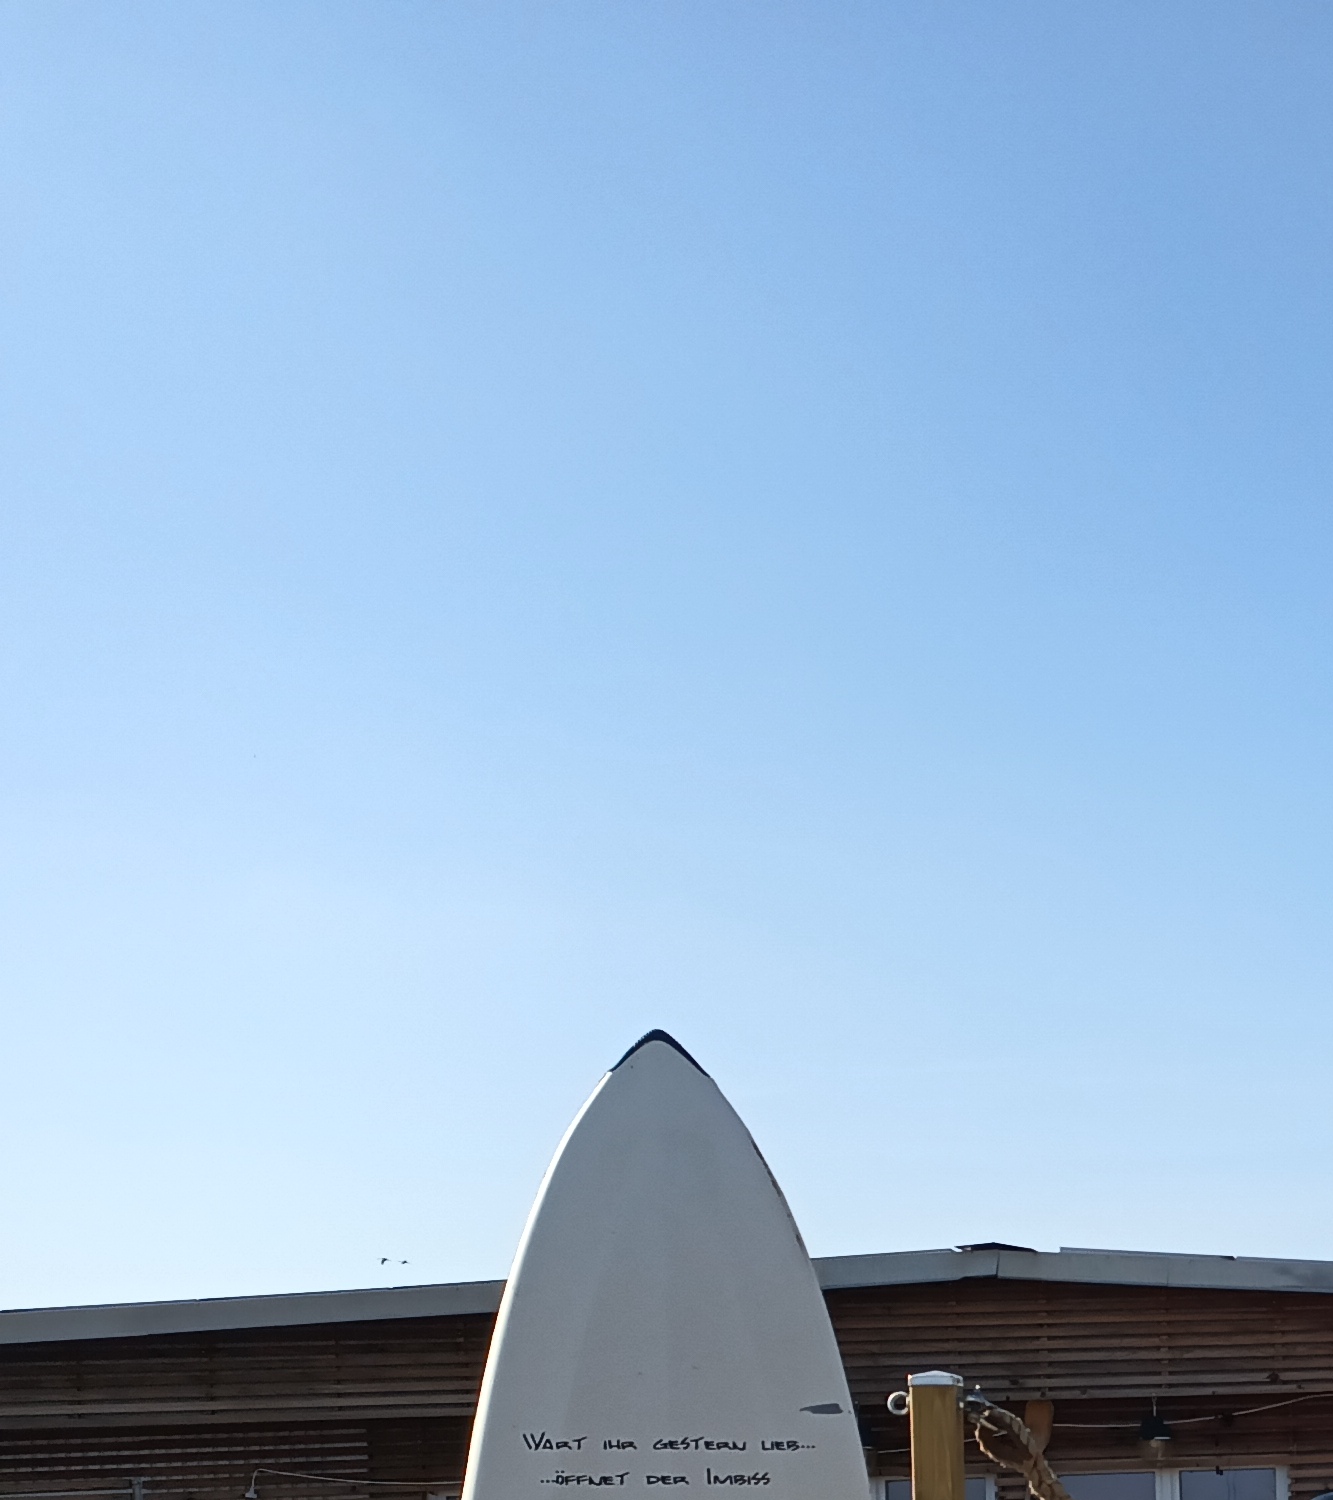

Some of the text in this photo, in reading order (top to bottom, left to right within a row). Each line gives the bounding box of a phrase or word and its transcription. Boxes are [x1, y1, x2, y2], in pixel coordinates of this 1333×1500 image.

[522, 1431, 588, 1451] WART
[603, 1439, 638, 1451] IHR
[652, 1436, 747, 1452] GESTERN
[645, 1475, 690, 1486] DER
[706, 1467, 771, 1486] IMBISS
